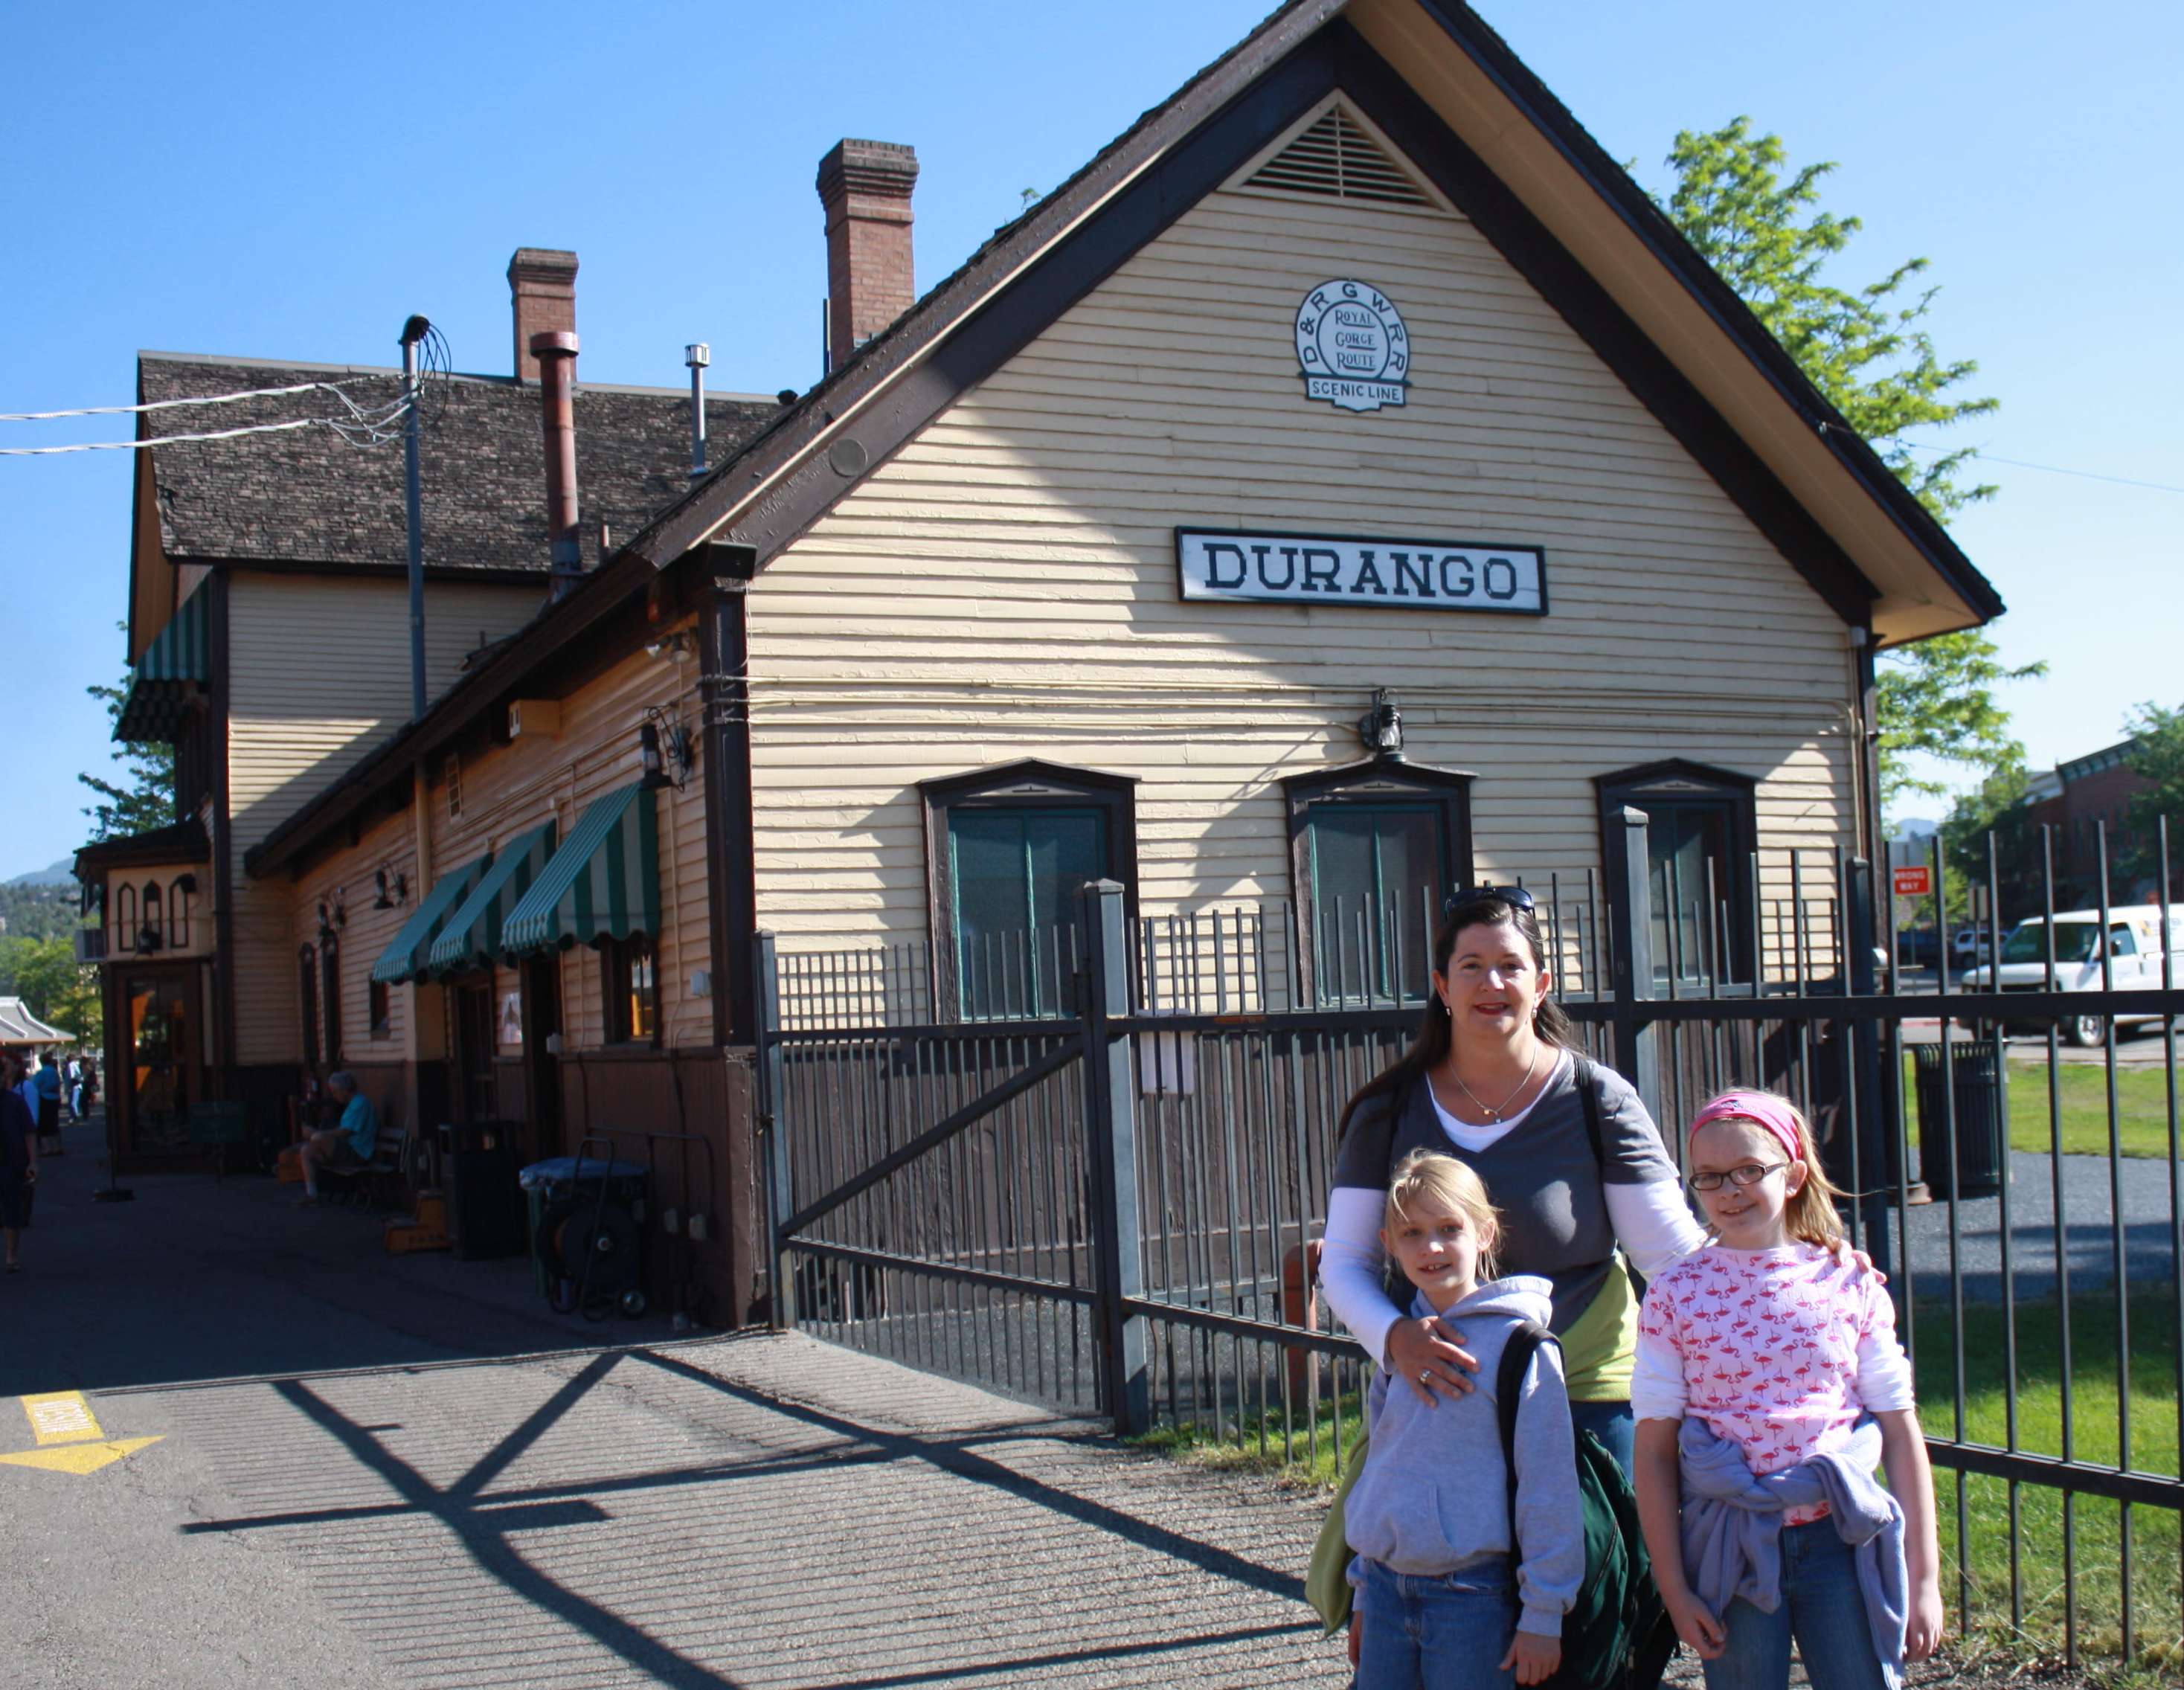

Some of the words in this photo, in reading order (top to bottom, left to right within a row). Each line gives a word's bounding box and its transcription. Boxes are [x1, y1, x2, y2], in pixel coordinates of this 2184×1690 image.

[1335, 309, 1375, 328] ROYAL
[1335, 332, 1375, 349] GORGE
[1337, 352, 1376, 371] ROUTE
[1312, 381, 1365, 397] SCENIC
[1369, 385, 1400, 401] LINE
[1202, 542, 1517, 600] DURANGO
[1899, 881, 1919, 891] WAY
